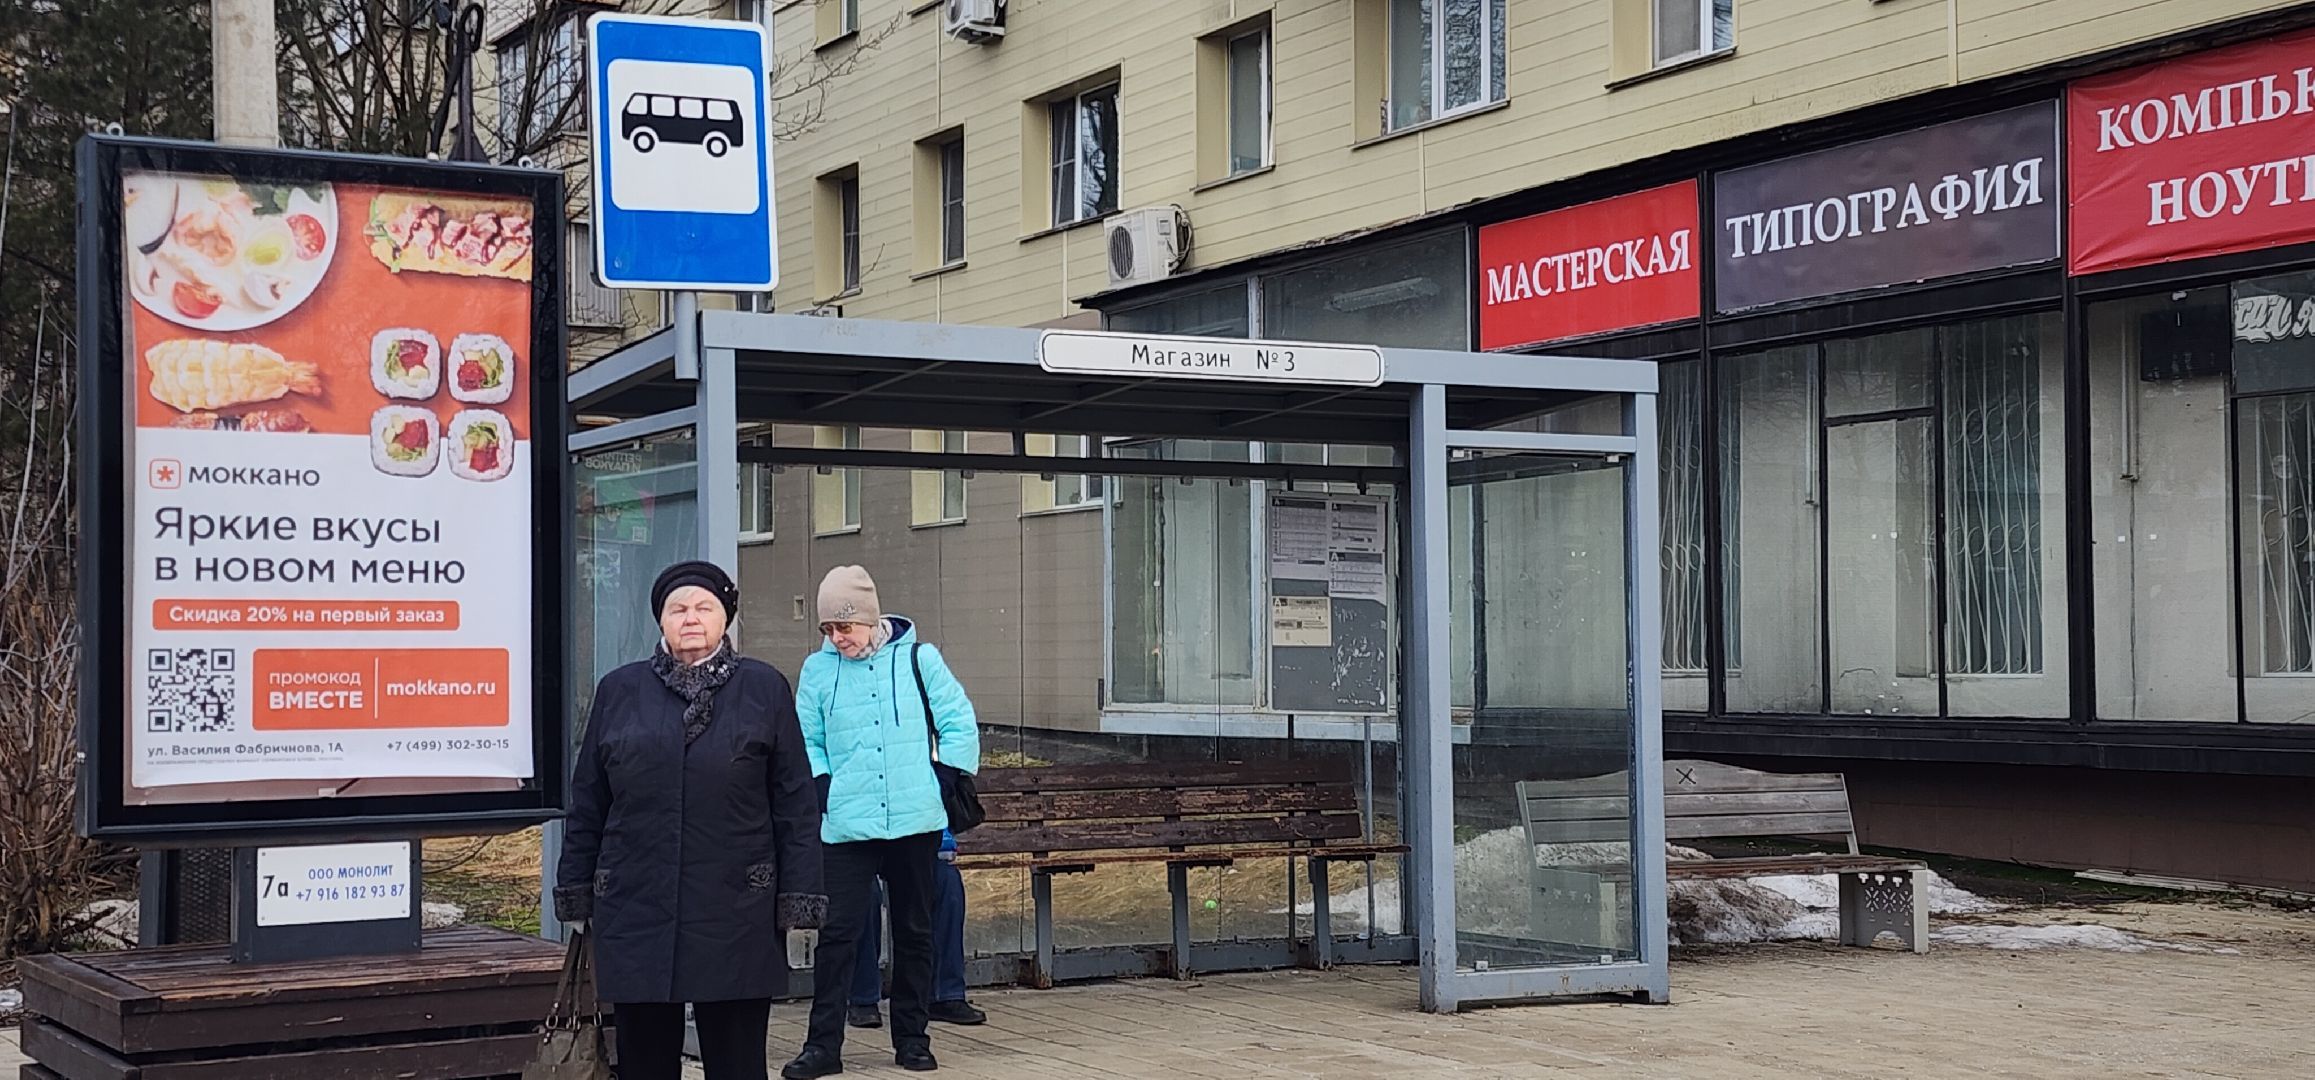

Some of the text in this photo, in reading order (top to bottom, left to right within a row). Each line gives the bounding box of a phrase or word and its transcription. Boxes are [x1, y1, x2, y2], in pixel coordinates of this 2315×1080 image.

[1725, 157, 2043, 259] ТИПОГРАФИЯ
[1487, 229, 1690, 305] МАСТЕРСКАЯ
[1131, 343, 1231, 368] Магазин
[154, 507, 440, 549] Яркие вкусы
[155, 557, 465, 584] в новом меню
[169, 605, 445, 624] Скидка 20% на первый заказ
[269, 672, 362, 687] промокод
[386, 679, 496, 696] mokkano.ru
[269, 690, 363, 710] ВМЕСТЕ
[147, 742, 344, 757] ул. Василия Фабричнова, 1А
[387, 739, 510, 752] +7 (499) 302-30-15
[308, 864, 393, 880] ООО МОНОЛИТ
[296, 883, 405, 901] +7 916 182 93 87
